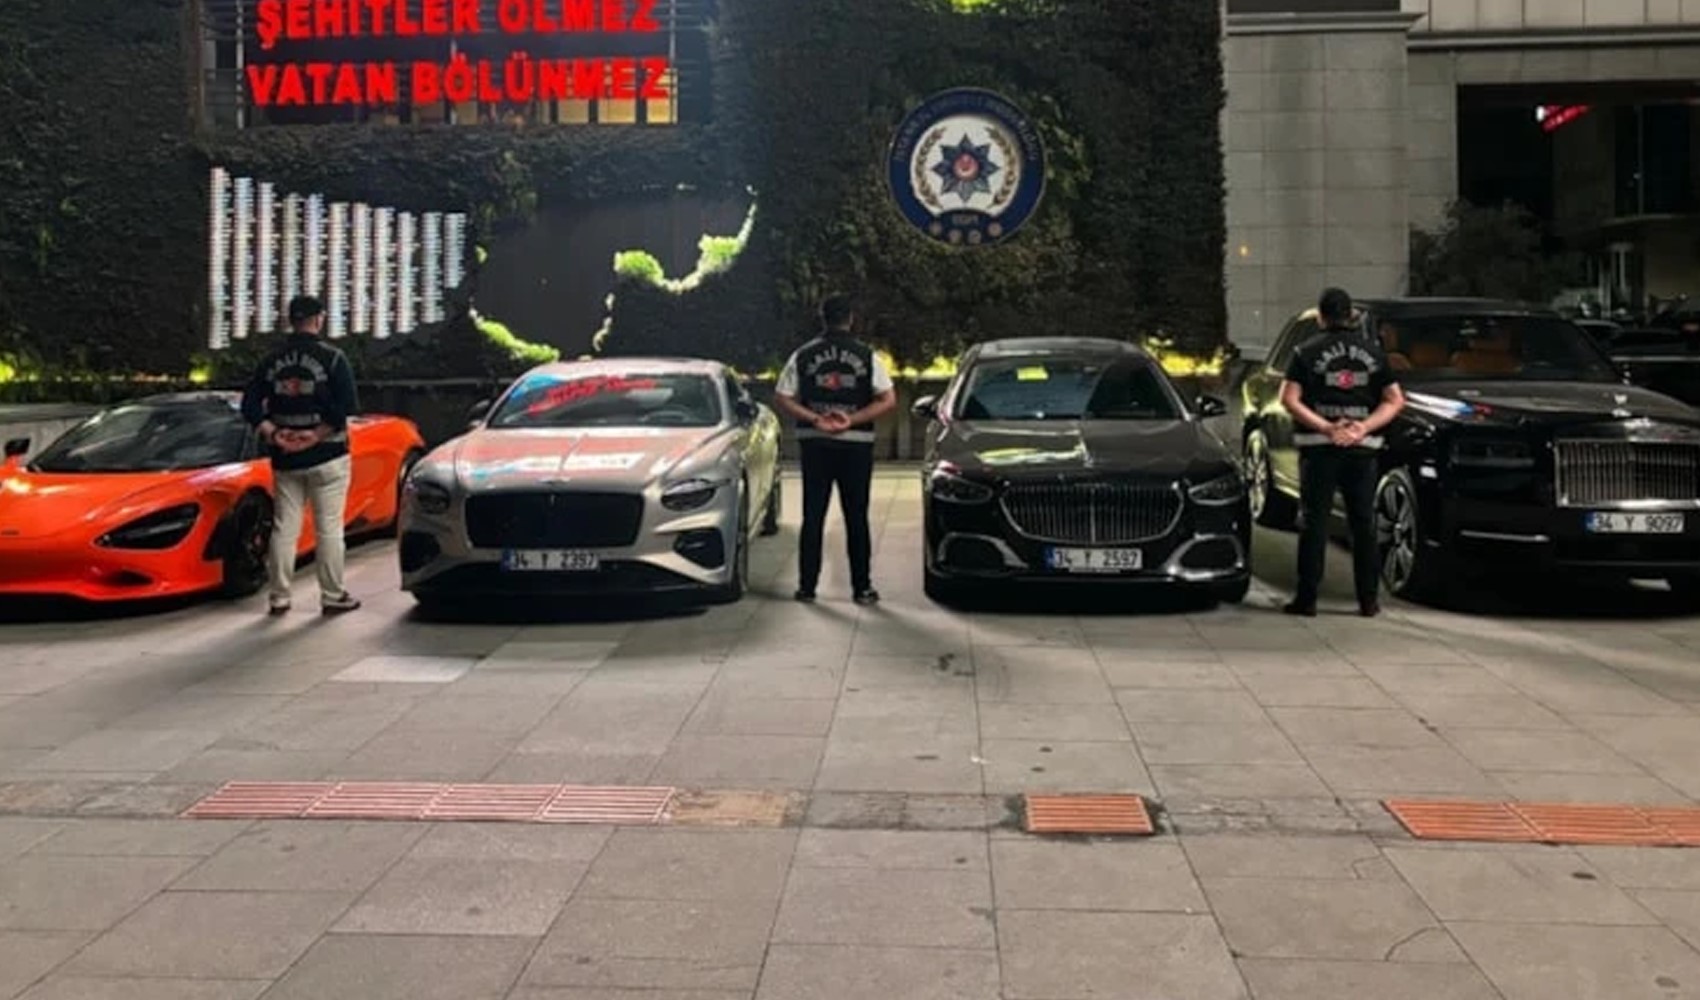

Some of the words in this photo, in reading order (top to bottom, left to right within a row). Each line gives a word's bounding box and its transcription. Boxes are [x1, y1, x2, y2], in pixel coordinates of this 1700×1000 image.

[247, 64, 396, 105] VATAN
[411, 52, 671, 103] BÖLÜNMEZ
[1597, 515, 1613, 531] 34
[1623, 515, 1635, 530] Y
[1644, 515, 1682, 531] 9097
[513, 552, 529, 568] 34
[1055, 550, 1073, 567] 34
[1102, 550, 1138, 567] 2597
